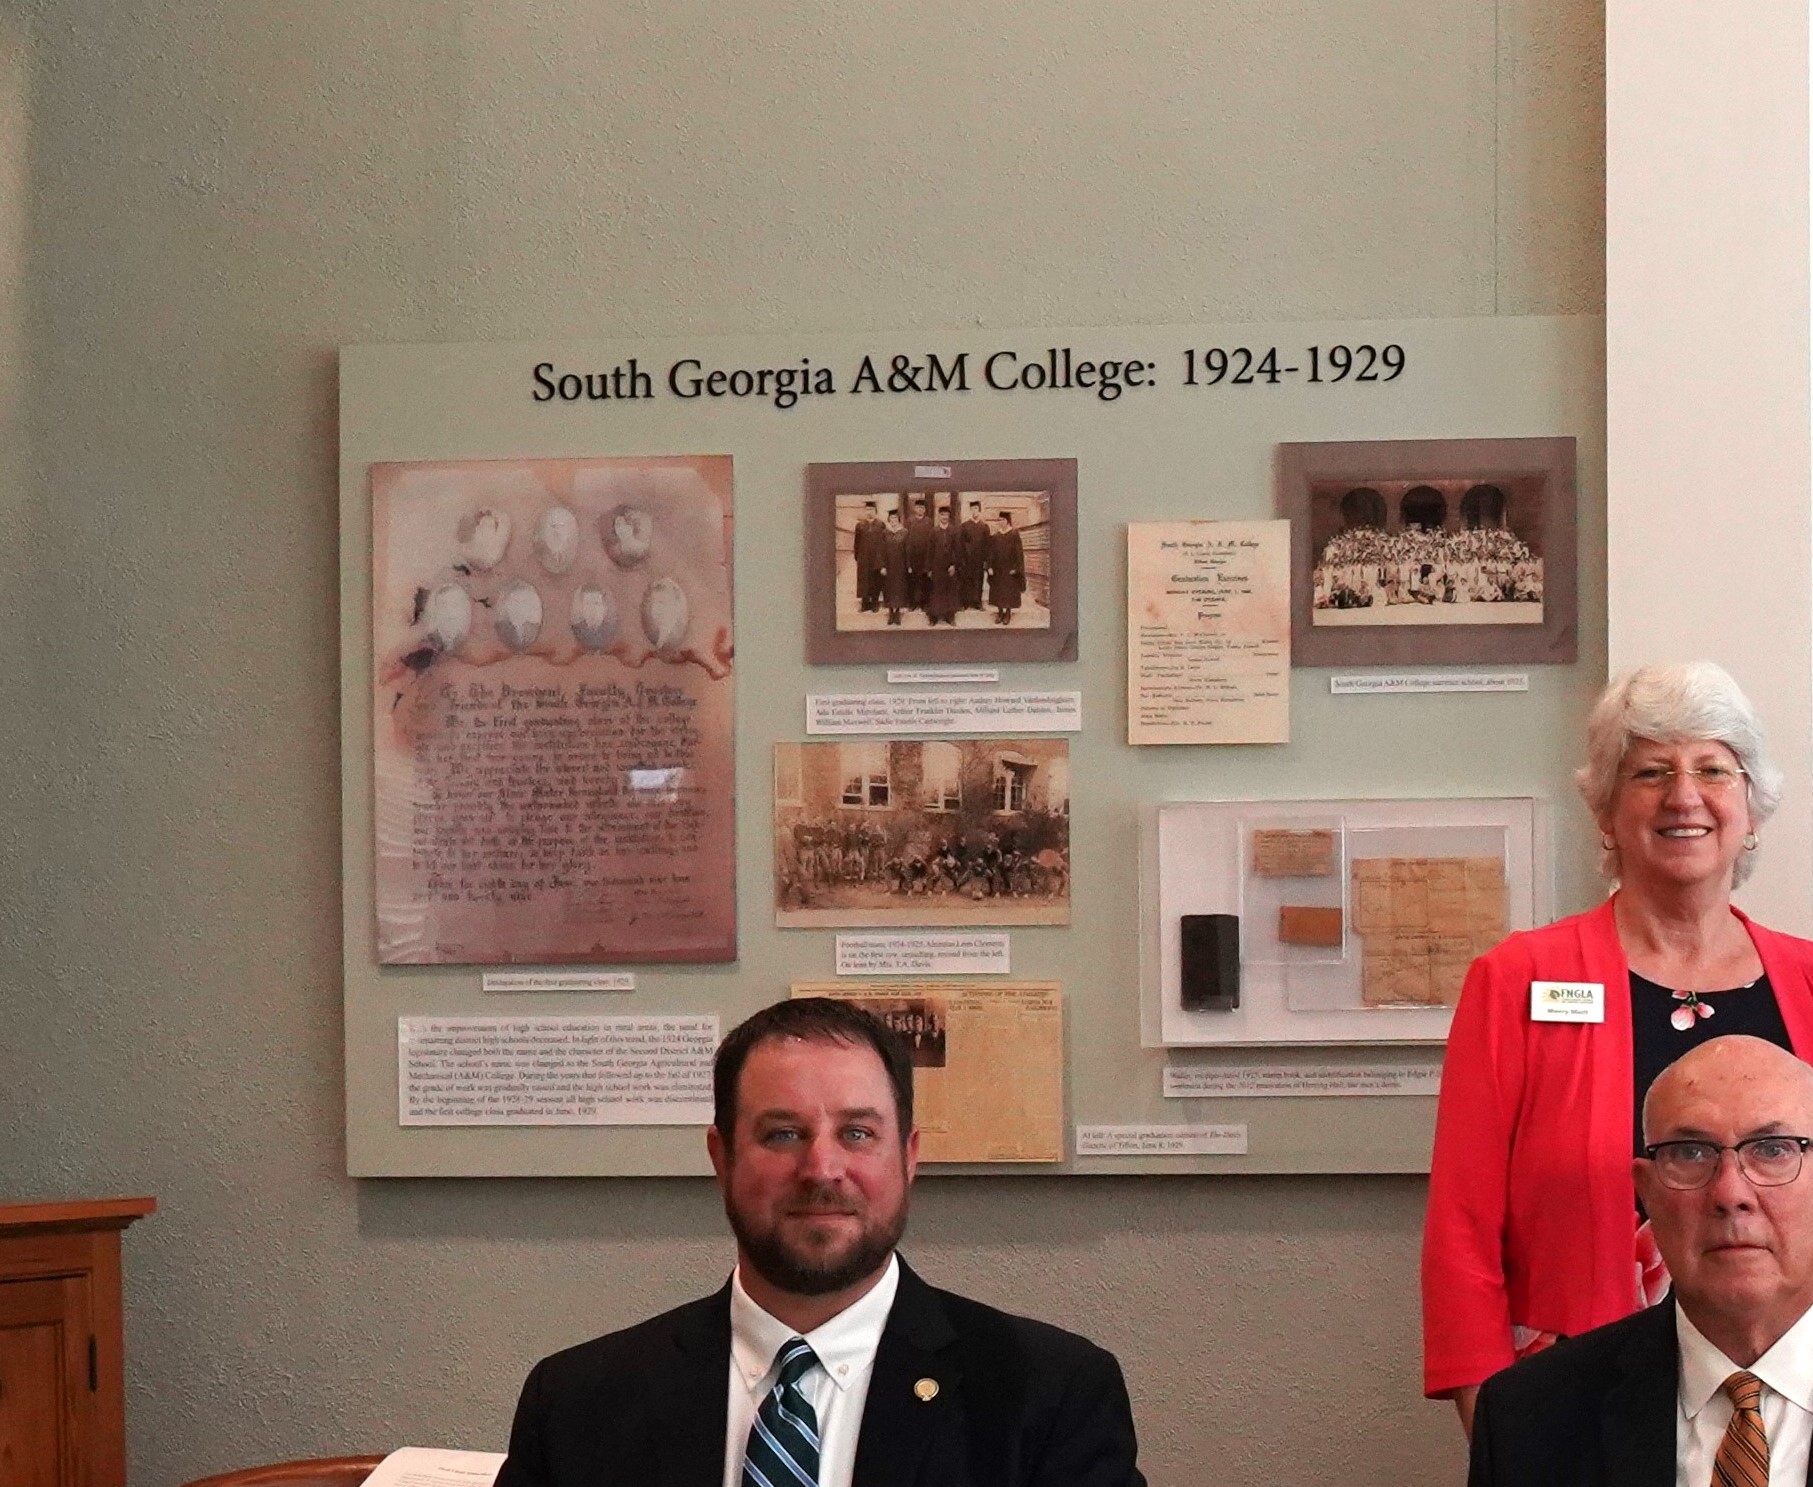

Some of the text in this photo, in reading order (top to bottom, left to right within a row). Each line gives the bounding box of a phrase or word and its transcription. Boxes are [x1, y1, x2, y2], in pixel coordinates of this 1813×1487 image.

[532, 343, 1406, 408] South Georgia A&M College: 1924-1929
